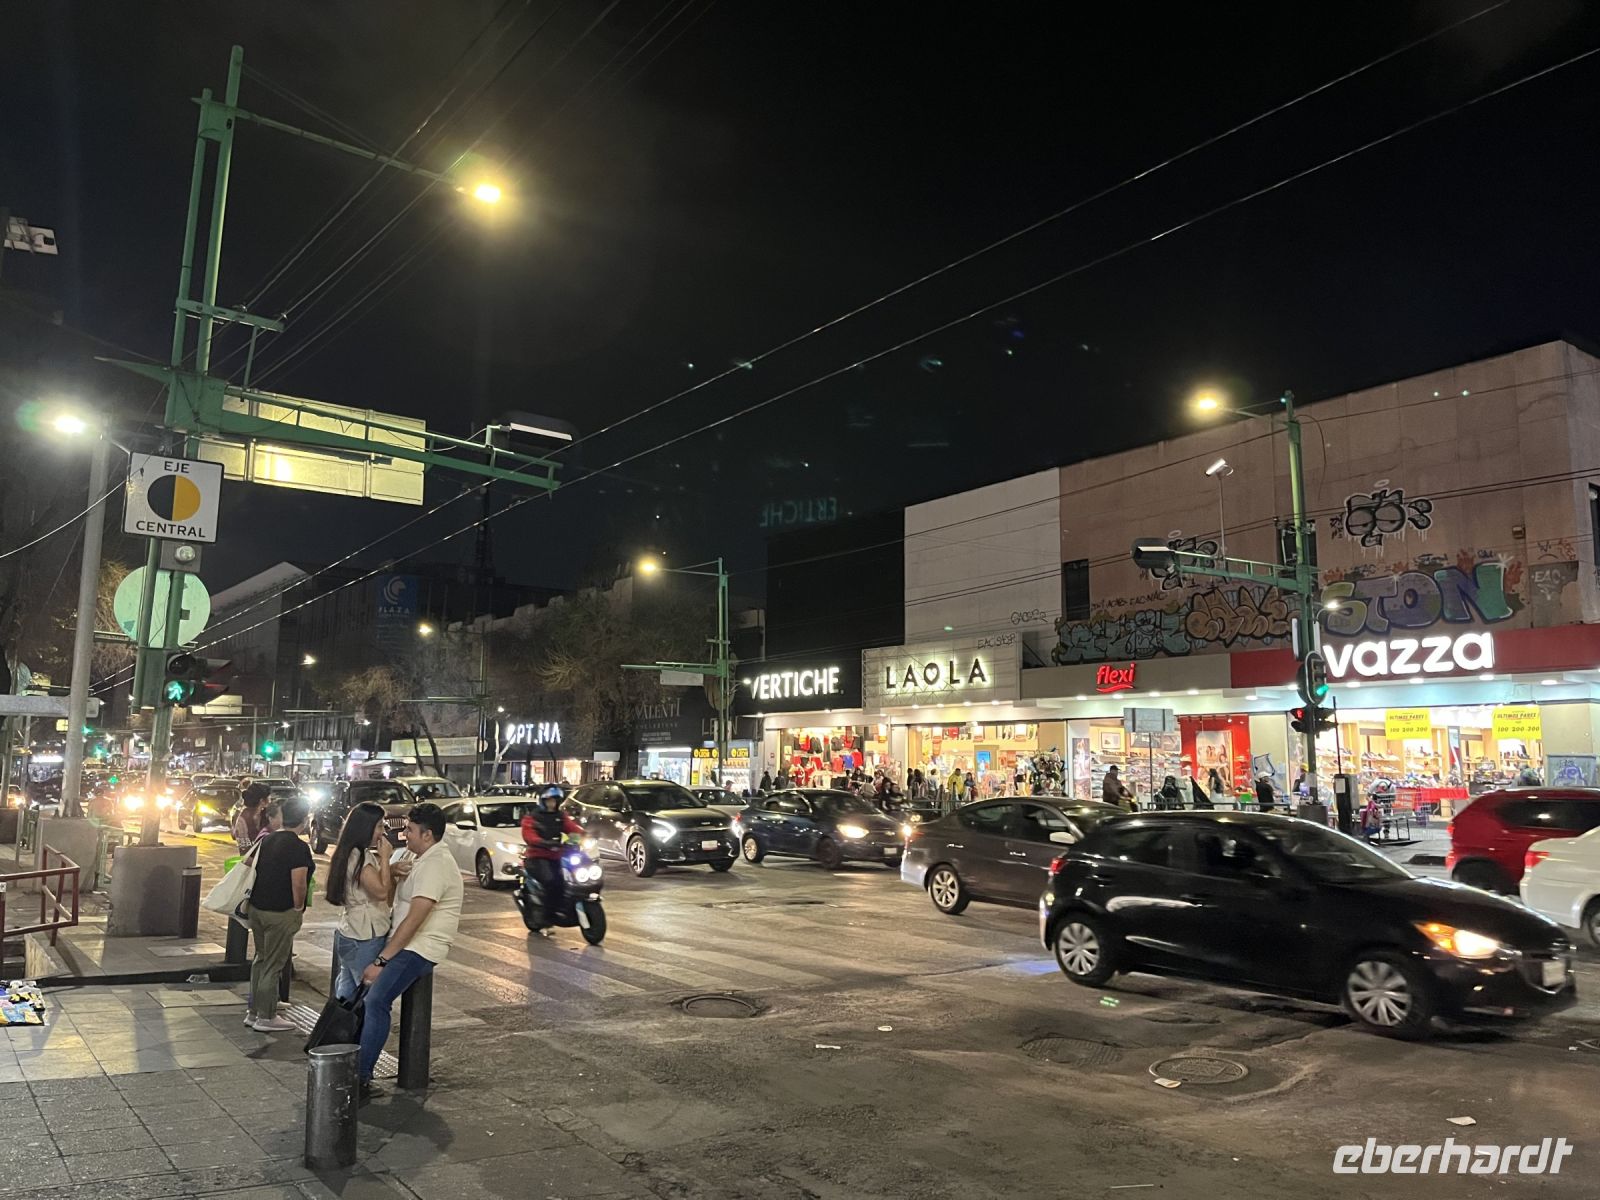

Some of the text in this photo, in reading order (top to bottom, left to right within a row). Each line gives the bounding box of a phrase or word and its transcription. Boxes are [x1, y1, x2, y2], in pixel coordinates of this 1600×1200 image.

[164, 460, 190, 474] EJE
[136, 520, 206, 538] CENTRAL
[1322, 632, 1495, 678] vazza
[750, 666, 840, 700] VERTICHE
[886, 658, 987, 689] LAOLA
[1097, 662, 1135, 685] flexi
